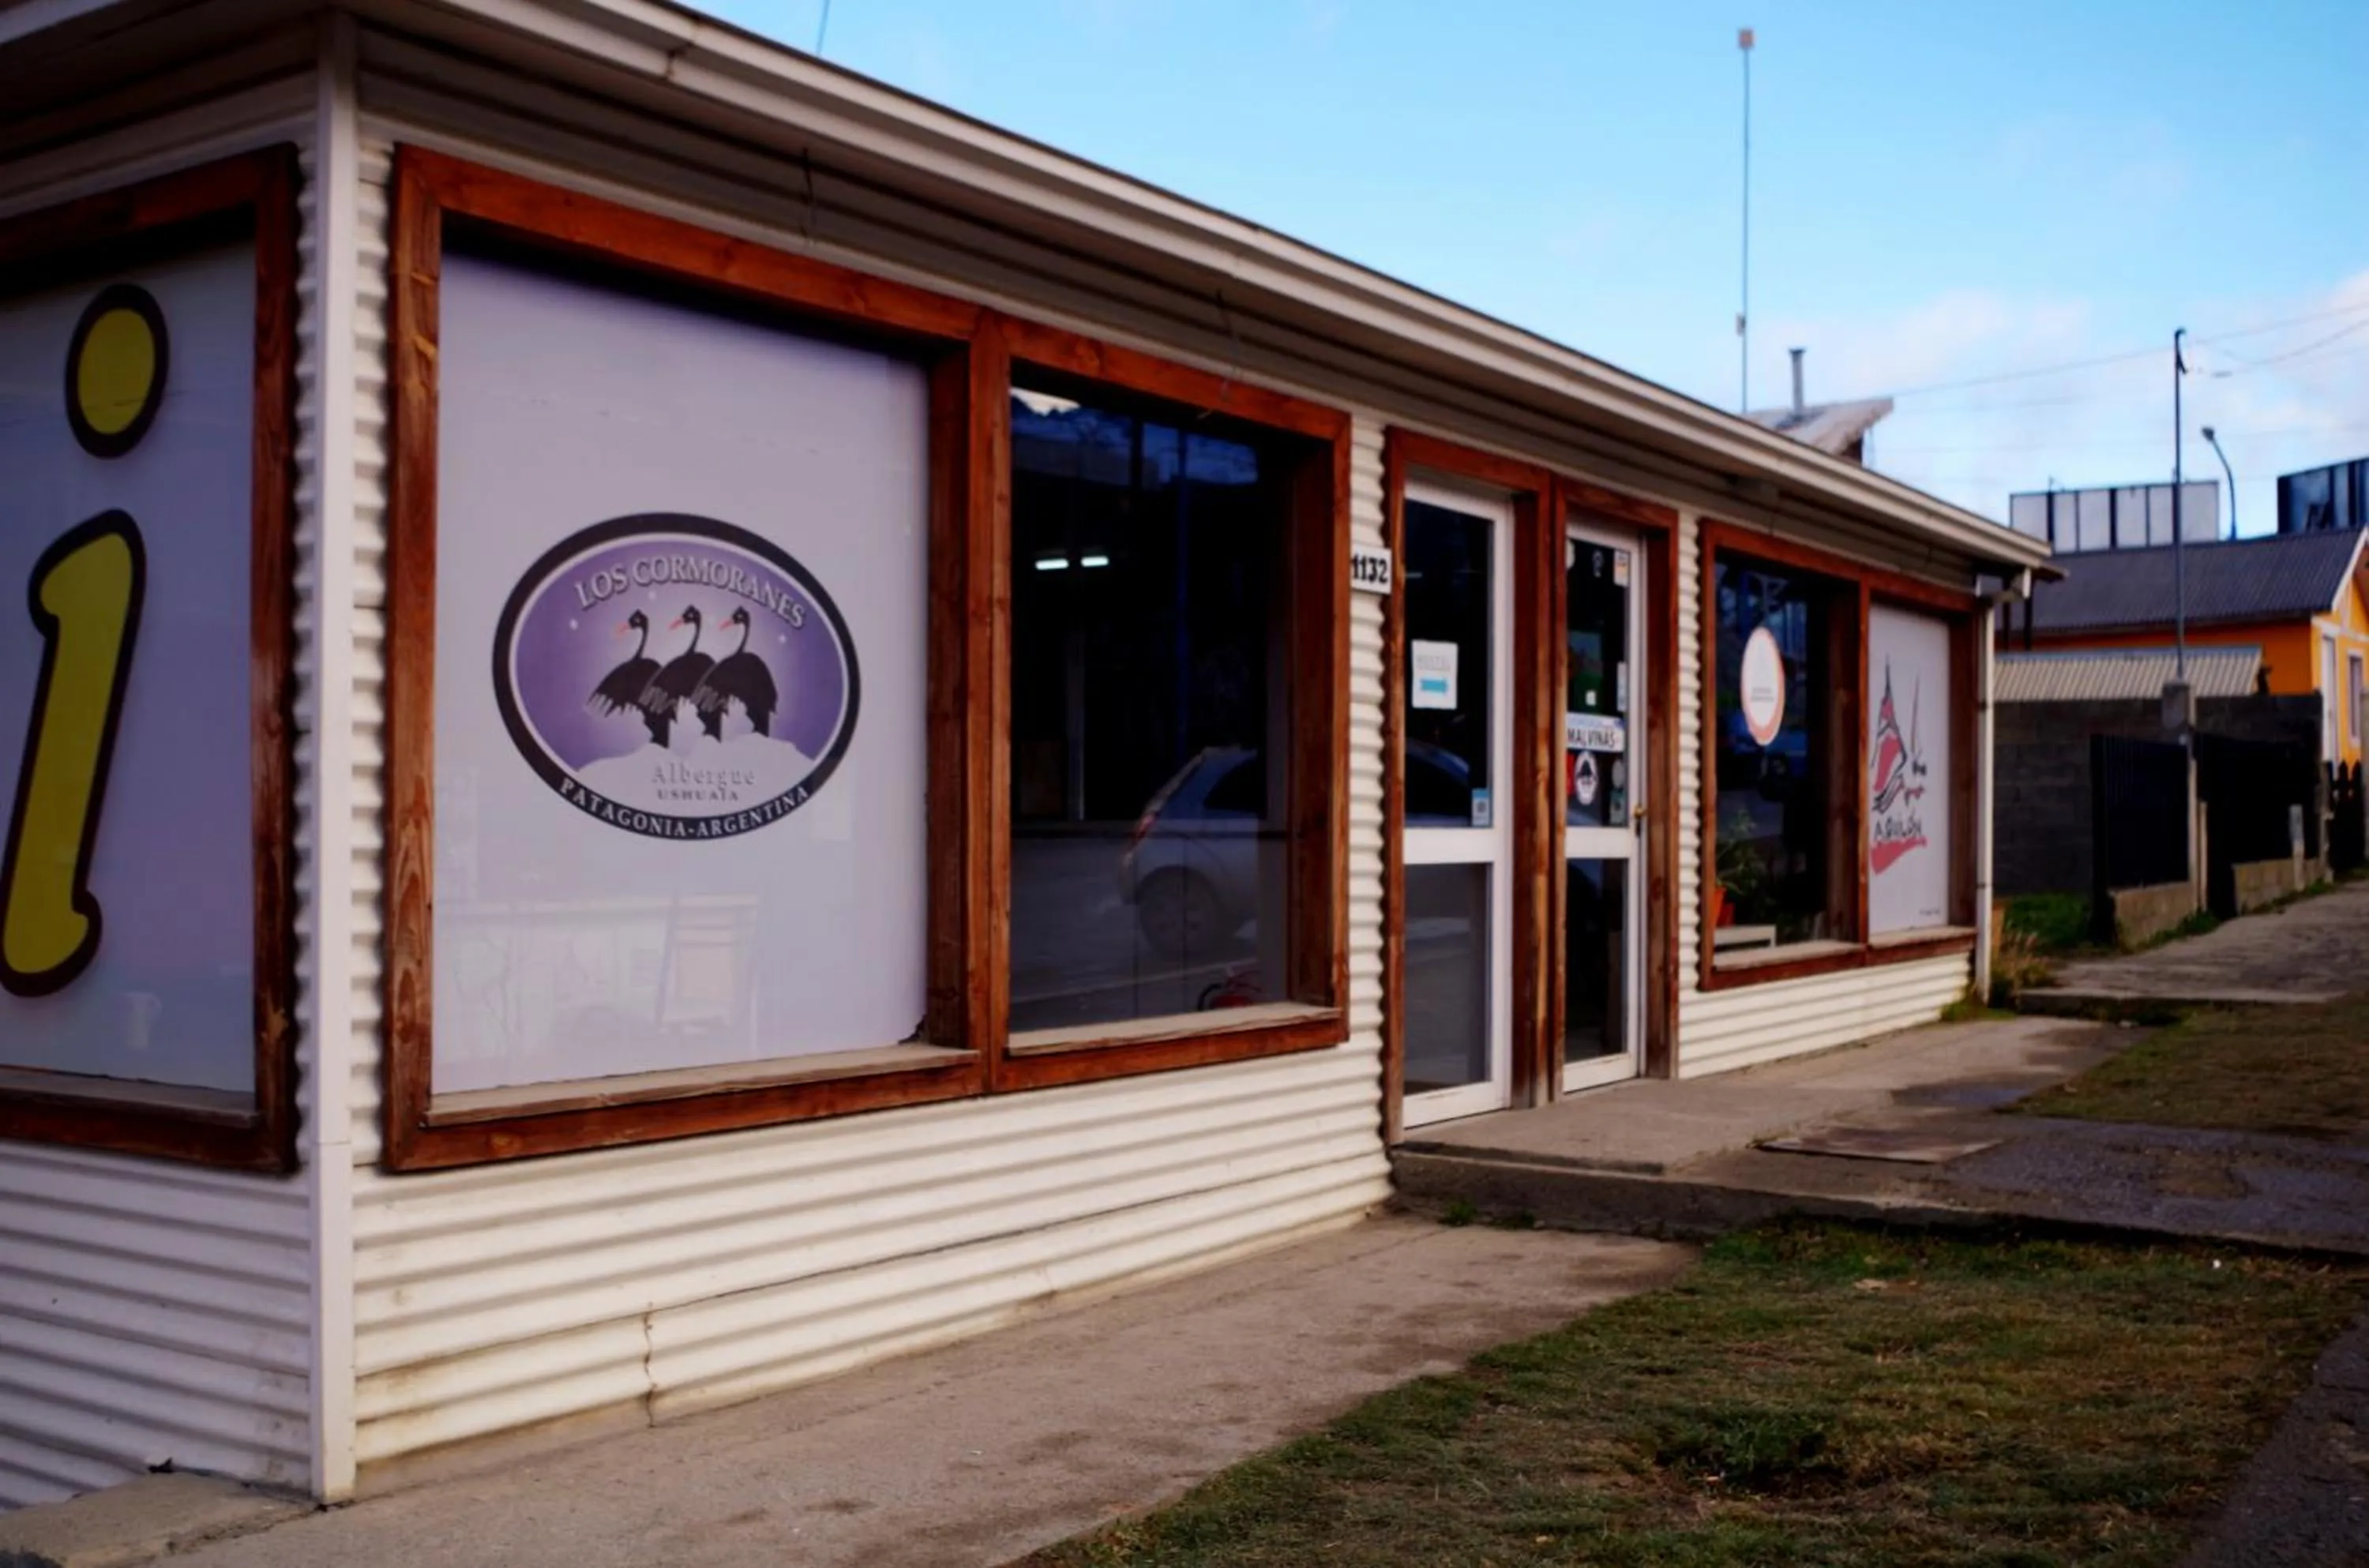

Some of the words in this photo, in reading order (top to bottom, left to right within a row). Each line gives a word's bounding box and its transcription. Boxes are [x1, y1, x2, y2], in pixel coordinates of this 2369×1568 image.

[1350, 553, 1388, 584] 1132
[575, 564, 629, 610] LOS
[633, 556, 805, 629] CORMORANES
[651, 762, 755, 790] Albergue
[657, 789, 739, 802] USHUAIA
